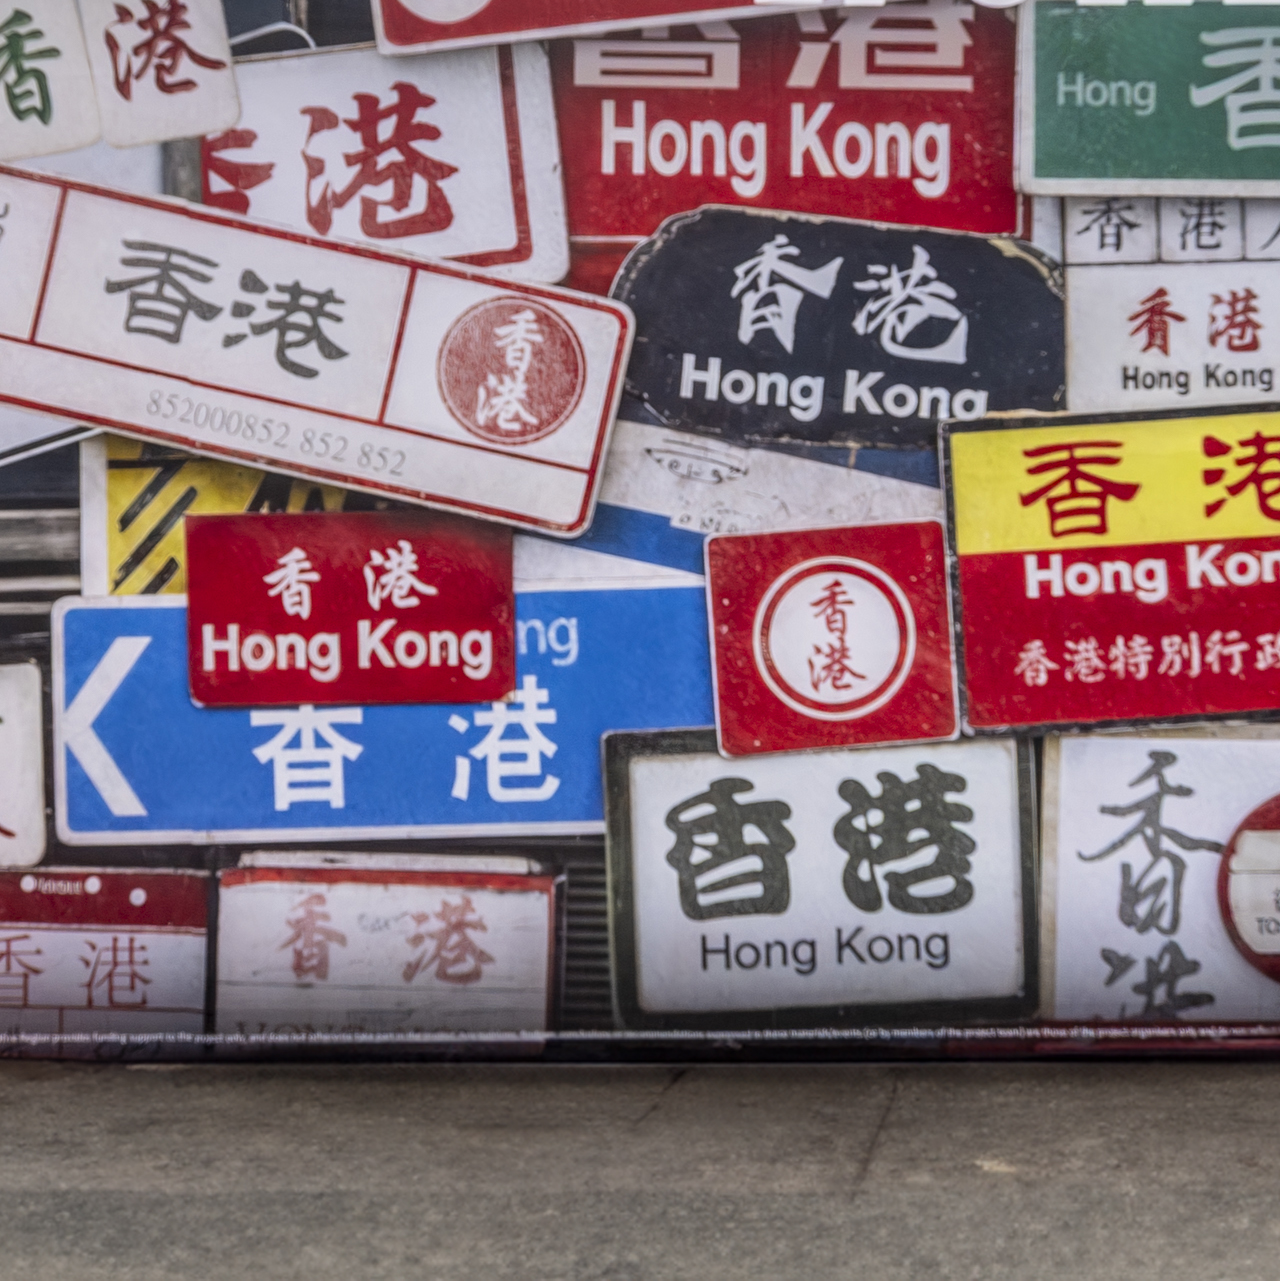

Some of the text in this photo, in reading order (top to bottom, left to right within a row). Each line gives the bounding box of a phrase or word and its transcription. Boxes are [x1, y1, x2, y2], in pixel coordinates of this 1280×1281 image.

[1056, 70, 1157, 117] Hong
[599, 98, 952, 199] Hong Kong
[105, 237, 351, 380] 香港
[730, 233, 969, 366] 香港
[1127, 285, 1266, 359] 香港
[475, 308, 545, 430] 香港
[678, 352, 826, 423] Hong
[1122, 361, 1275, 397] Hong Kong
[144, 388, 408, 478] 852000852 852 852
[262, 540, 439, 620] 香港
[1023, 551, 1170, 605] Hong
[200, 617, 495, 683] Hong Kong
[808, 579, 868, 693] 香港
[249, 675, 564, 812] 香港
[665, 761, 978, 922] 香港
[276, 893, 497, 985] 香港
[699, 925, 952, 974] Hong Kong
